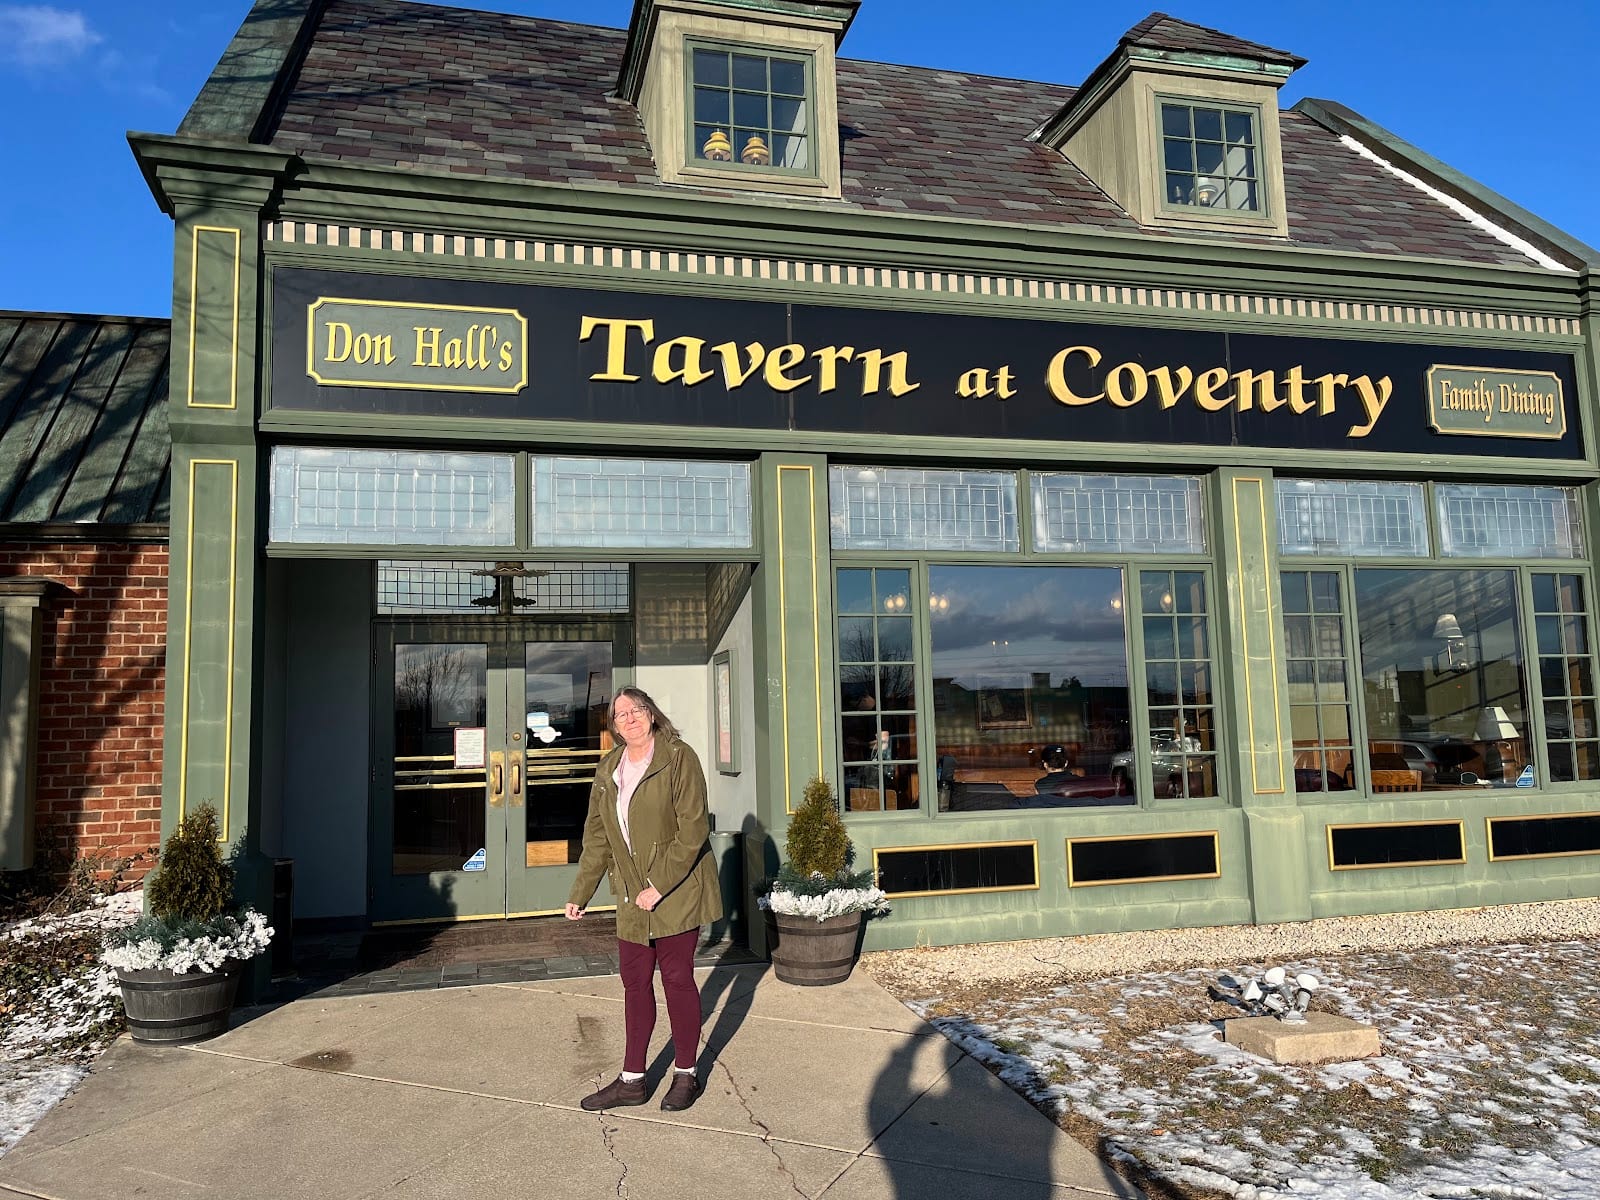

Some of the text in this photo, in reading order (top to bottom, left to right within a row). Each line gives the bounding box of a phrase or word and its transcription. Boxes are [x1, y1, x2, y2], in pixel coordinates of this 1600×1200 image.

[324, 321, 513, 372] Don Hall's
[578, 314, 1394, 439] Tavern at Coventry
[1439, 378, 1555, 424] Family Dining
